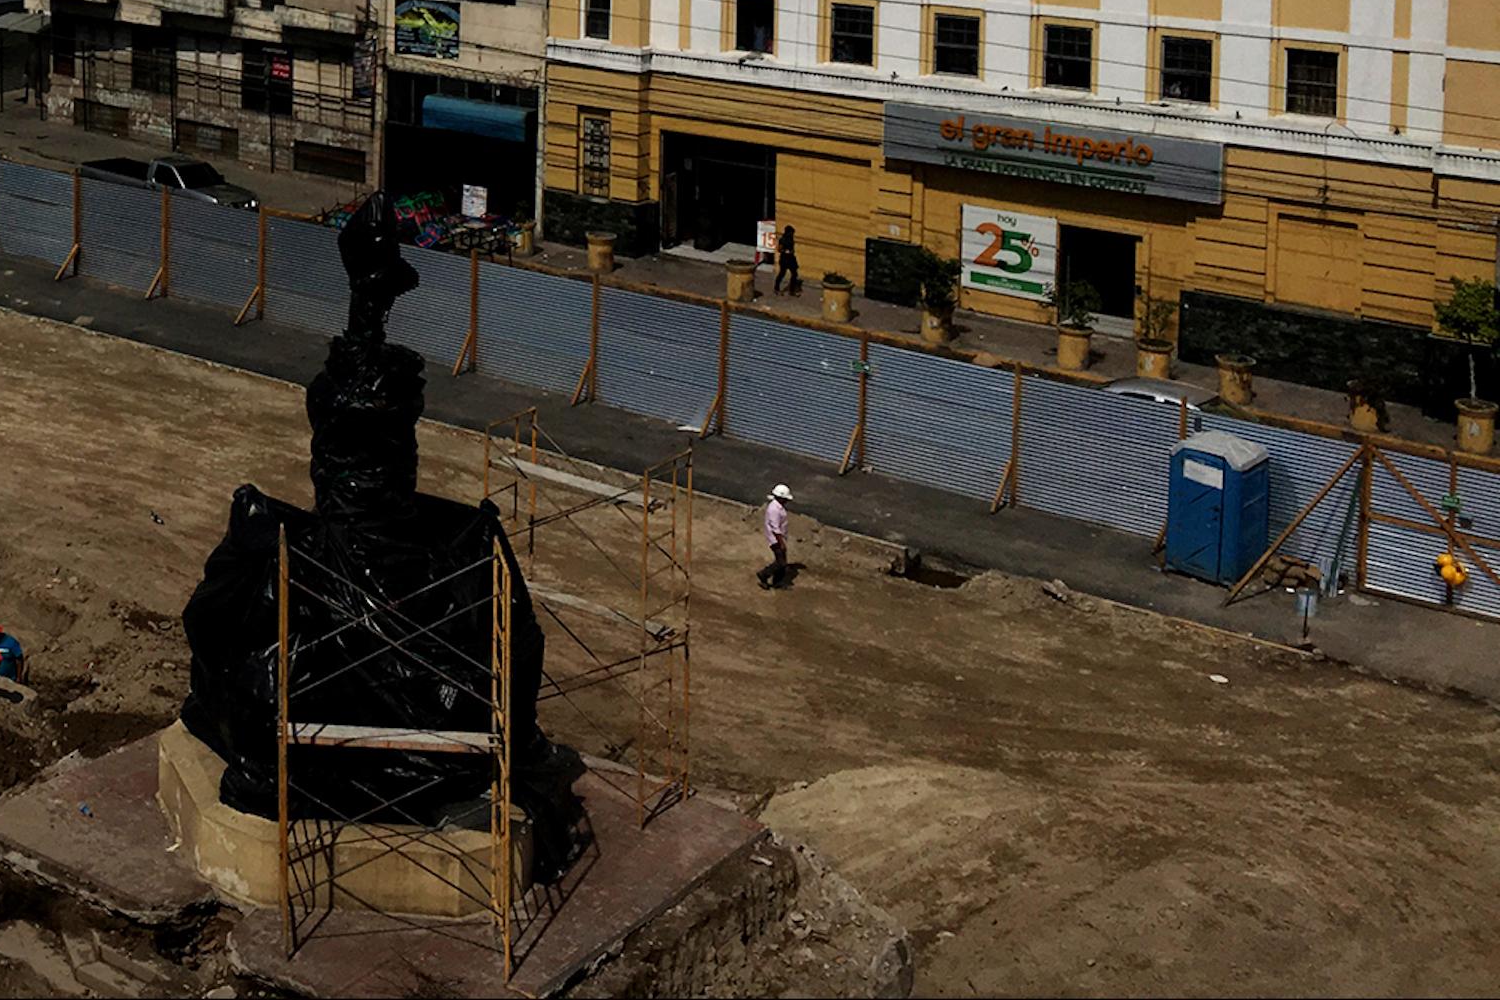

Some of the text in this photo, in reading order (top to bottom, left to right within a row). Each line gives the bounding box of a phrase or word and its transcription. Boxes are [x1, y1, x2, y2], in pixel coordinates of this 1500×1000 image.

[939, 116, 965, 143] el
[972, 122, 1033, 151] gran
[943, 155, 959, 167] LA
[961, 158, 992, 171] GRAN
[997, 213, 1017, 227] hoy
